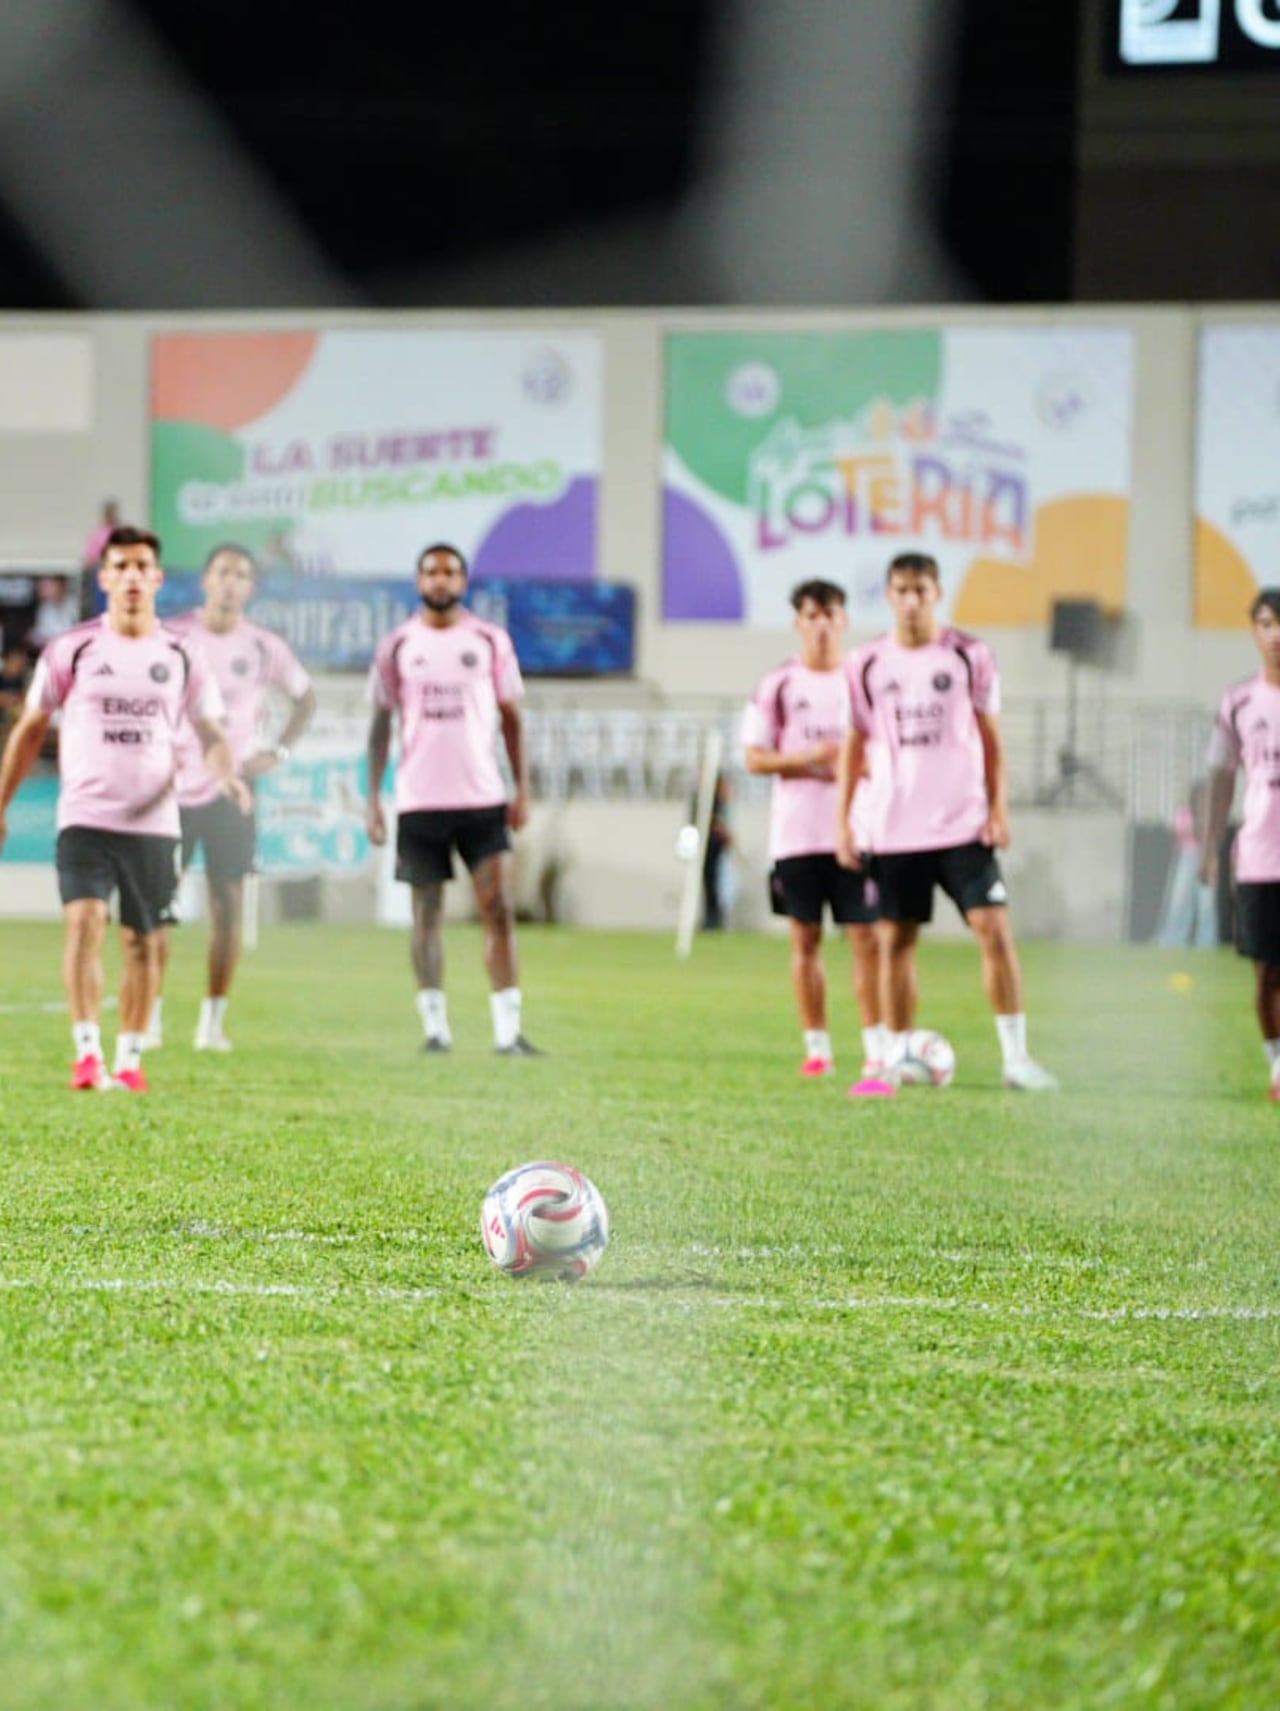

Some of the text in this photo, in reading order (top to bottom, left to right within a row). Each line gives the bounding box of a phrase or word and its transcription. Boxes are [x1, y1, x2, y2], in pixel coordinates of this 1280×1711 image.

[251, 426, 498, 474] LA SUERTE
[308, 459, 562, 514] BUSCANDO
[103, 697, 159, 716] ERGO
